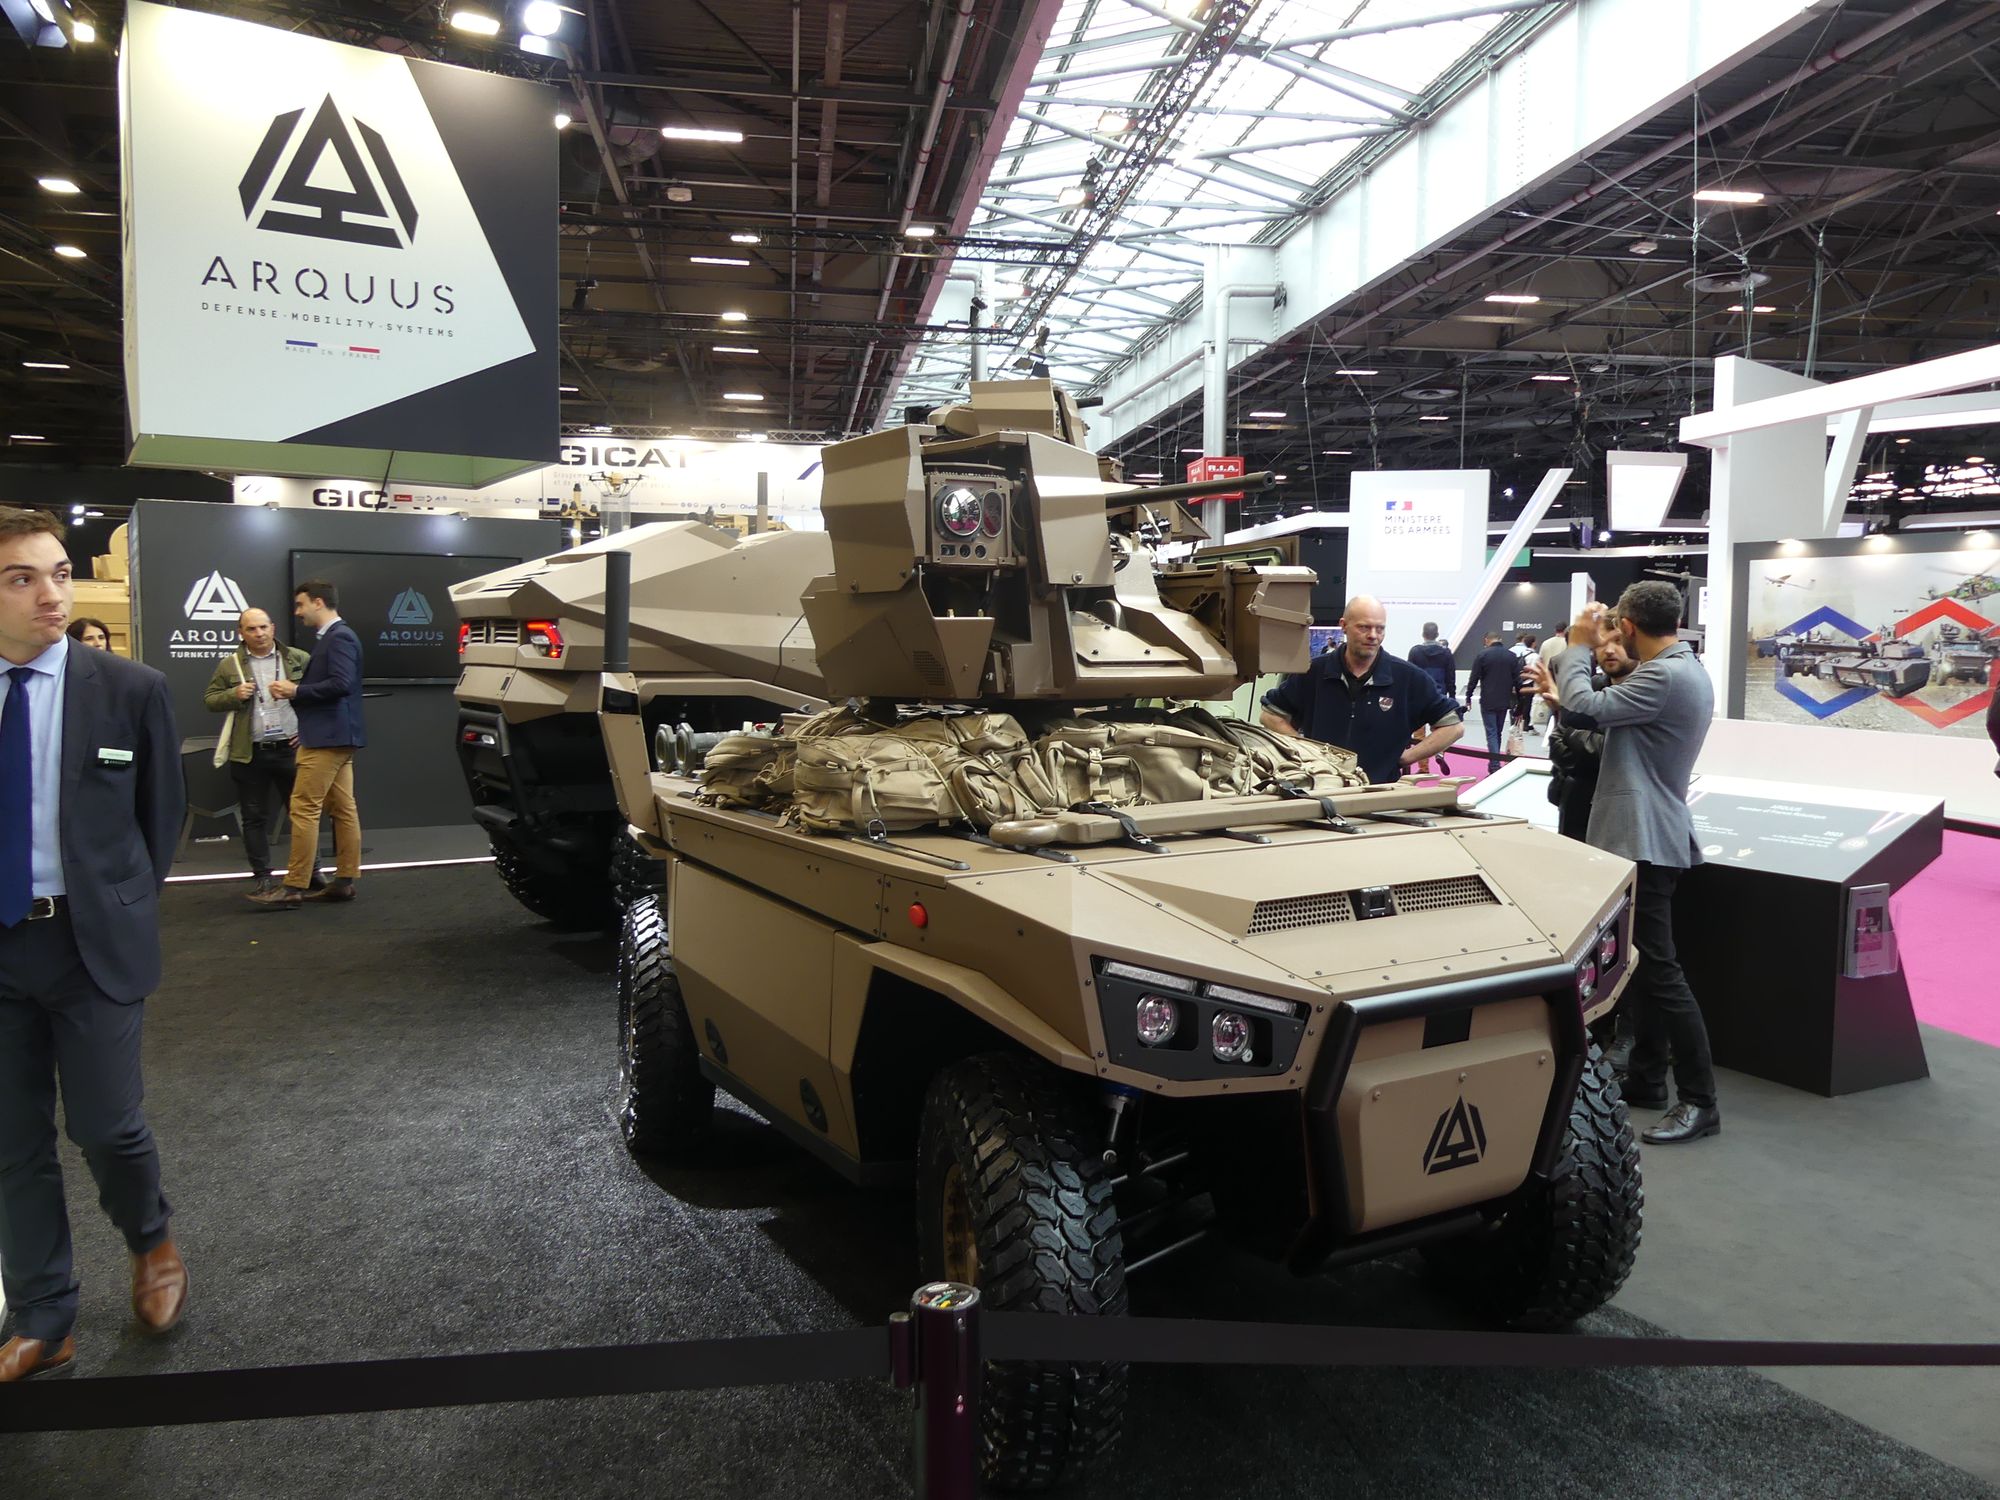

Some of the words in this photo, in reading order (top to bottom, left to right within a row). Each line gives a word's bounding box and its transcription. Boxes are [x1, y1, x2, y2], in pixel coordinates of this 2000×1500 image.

[201, 255, 455, 314] ARQUUS
[285, 346, 312, 354] MADE
[170, 629, 244, 642] ARQU
[170, 651, 217, 659] TURNKEY
